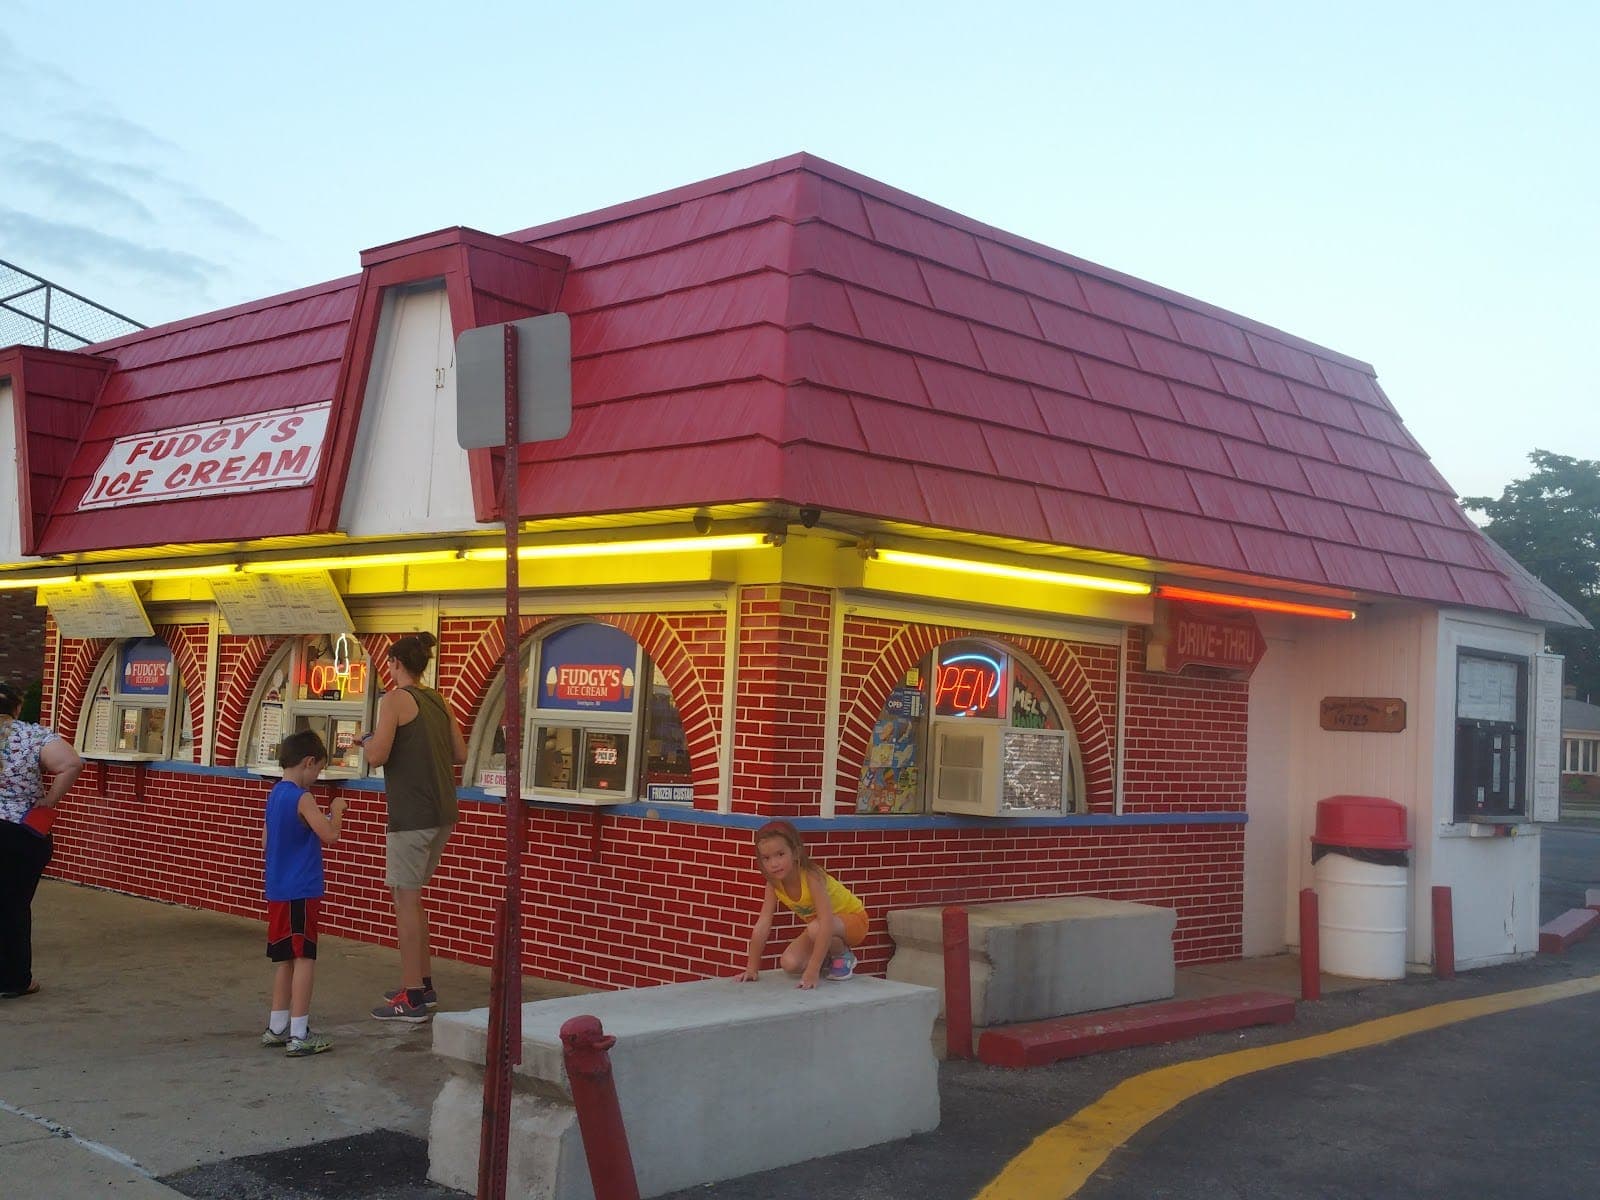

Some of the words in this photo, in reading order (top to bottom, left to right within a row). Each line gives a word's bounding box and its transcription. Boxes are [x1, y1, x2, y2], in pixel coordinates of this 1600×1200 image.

[126, 416, 304, 466] FUDGY'S
[92, 469, 153, 499] ICE
[165, 445, 312, 490] CREAM
[1177, 621, 1256, 663] DRIVE-THRU
[132, 663, 166, 677] FUDGY'S
[135, 676, 143, 684] ICE
[143, 676, 159, 684] CREAM
[560, 668, 621, 687] FUDGY'S
[567, 686, 580, 696] ICE
[581, 686, 608, 697] CREAM
[483, 773, 494, 785] ICE
[652, 787, 672, 801] FROZEN
[673, 787, 694, 801] CUSTAR
